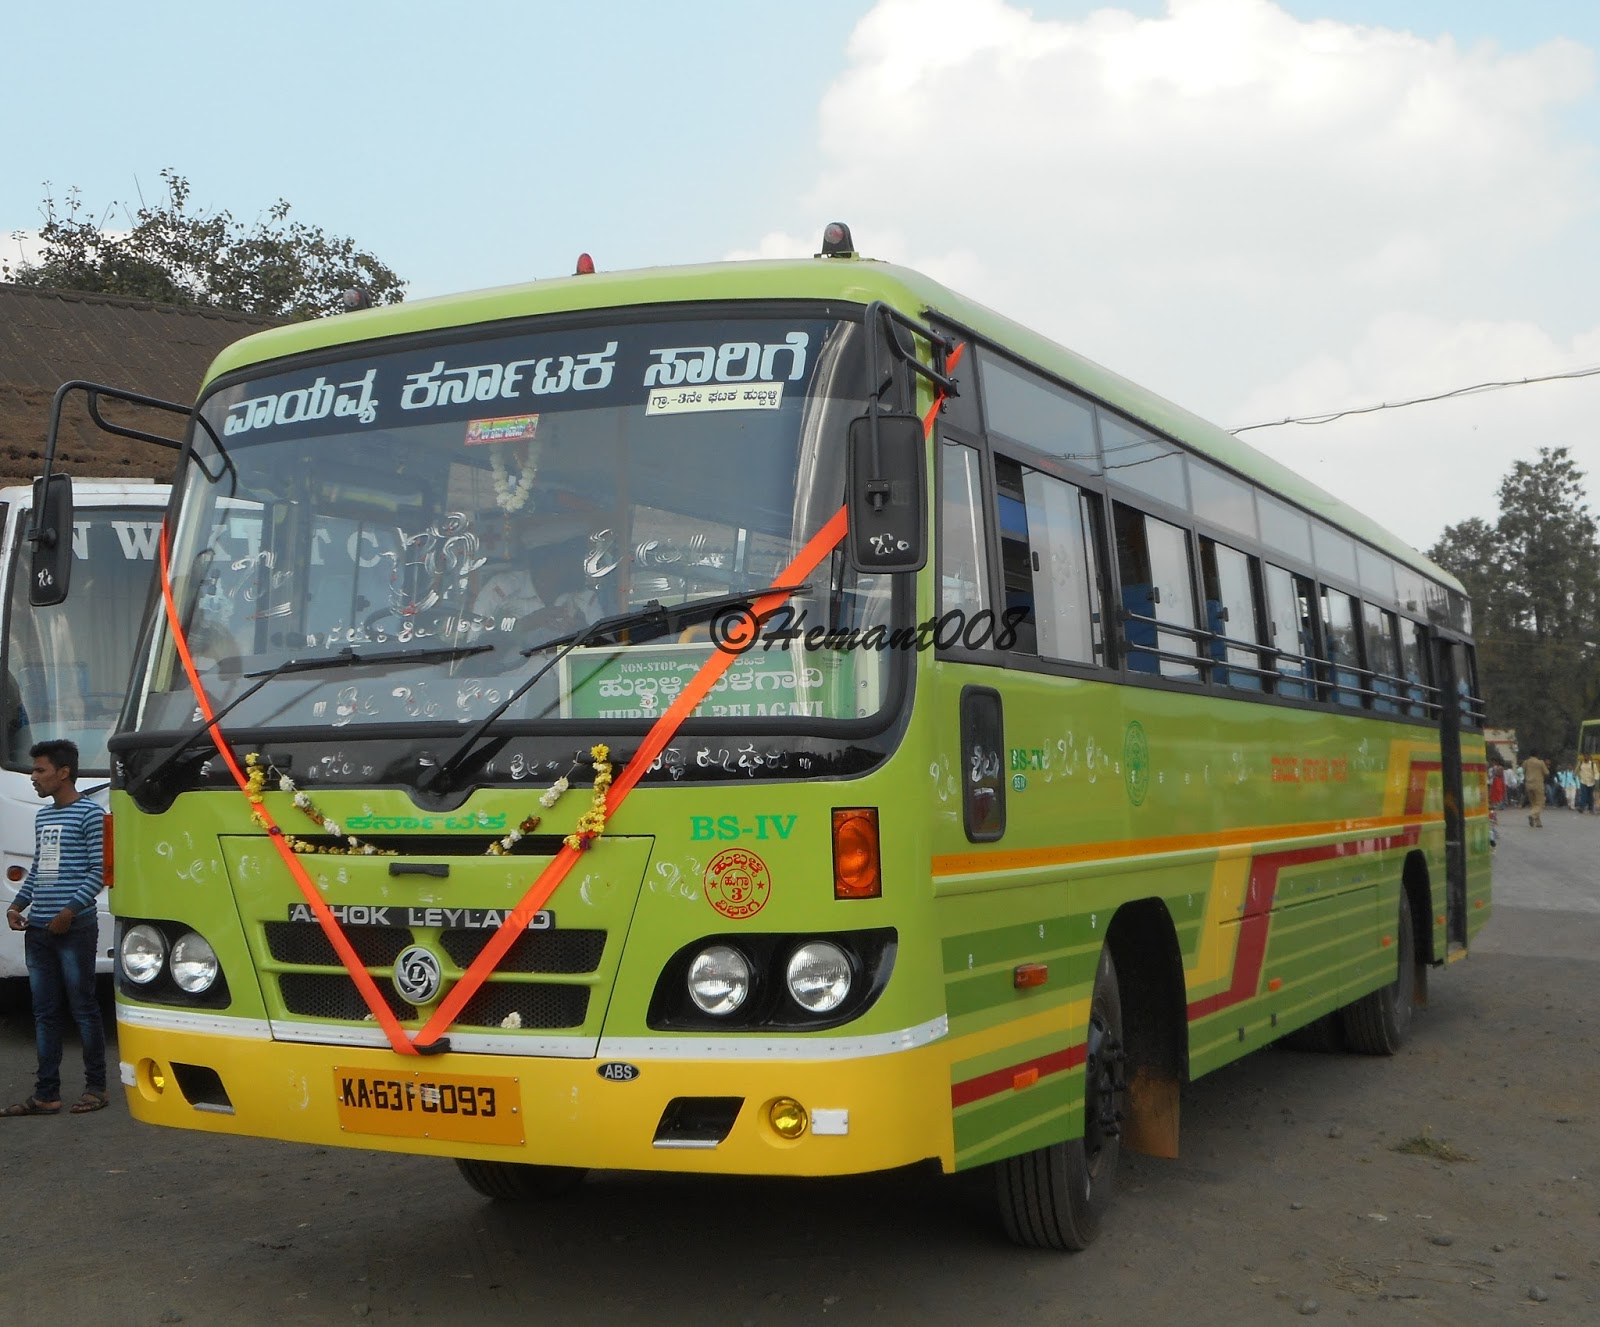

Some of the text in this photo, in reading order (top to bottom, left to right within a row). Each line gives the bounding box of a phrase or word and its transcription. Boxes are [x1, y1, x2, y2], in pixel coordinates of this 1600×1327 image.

[223, 331, 809, 437] ವಾಯವ್ಯ ಕರ್ನಾಟಕ ಸಾರಿಗೆ
[620, 661, 677, 673] NON-STOP
[690, 815, 797, 841] BS-IV
[731, 887, 743, 900] 3
[605, 1064, 632, 1080] ABS
